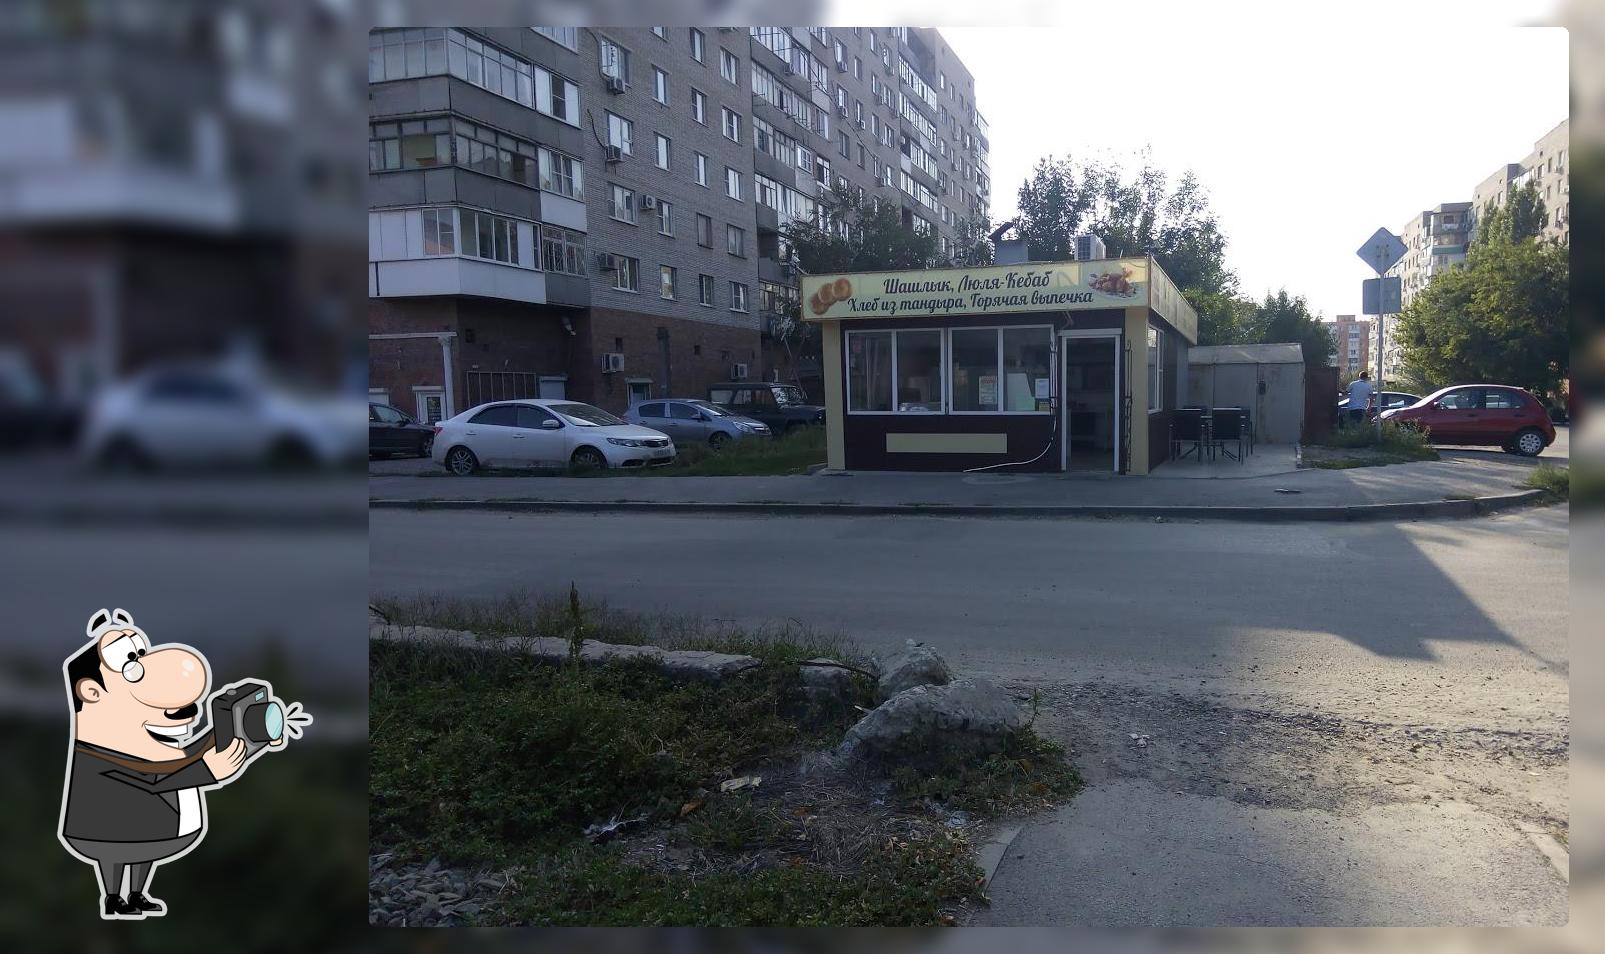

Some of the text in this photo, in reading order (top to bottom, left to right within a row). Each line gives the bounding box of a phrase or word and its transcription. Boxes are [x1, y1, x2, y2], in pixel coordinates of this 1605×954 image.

[884, 270, 1053, 294] Шашлык, Люля-Кебаб
[847, 290, 1094, 315] Хлеб из тандыра, Горячая выпечка
